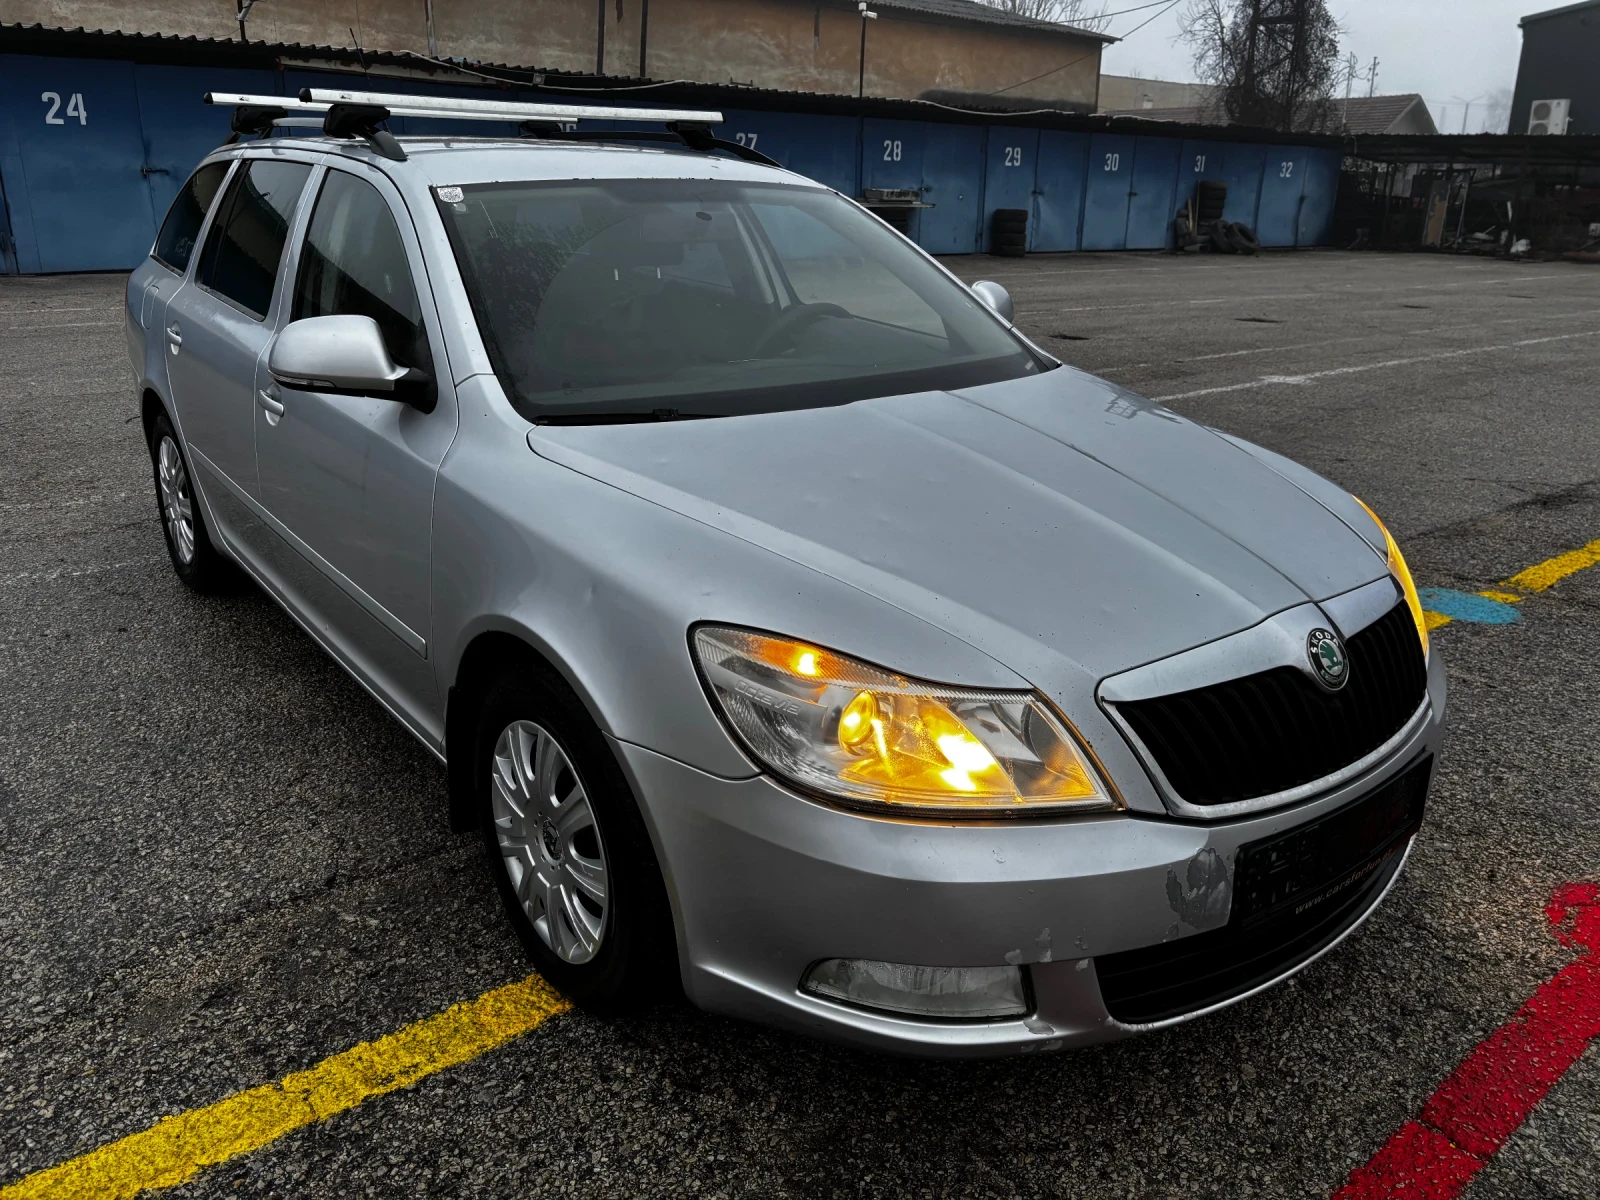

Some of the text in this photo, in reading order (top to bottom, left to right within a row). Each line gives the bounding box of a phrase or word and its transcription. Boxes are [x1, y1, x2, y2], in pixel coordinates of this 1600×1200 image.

[41, 91, 88, 126] 24
[736, 132, 758, 150] 27
[883, 139, 902, 162] 28
[1004, 146, 1022, 167] 29
[1104, 153, 1120, 172] 30
[1194, 155, 1206, 173] 31
[1279, 161, 1293, 178] 32
[734, 679, 801, 716] Octavia
